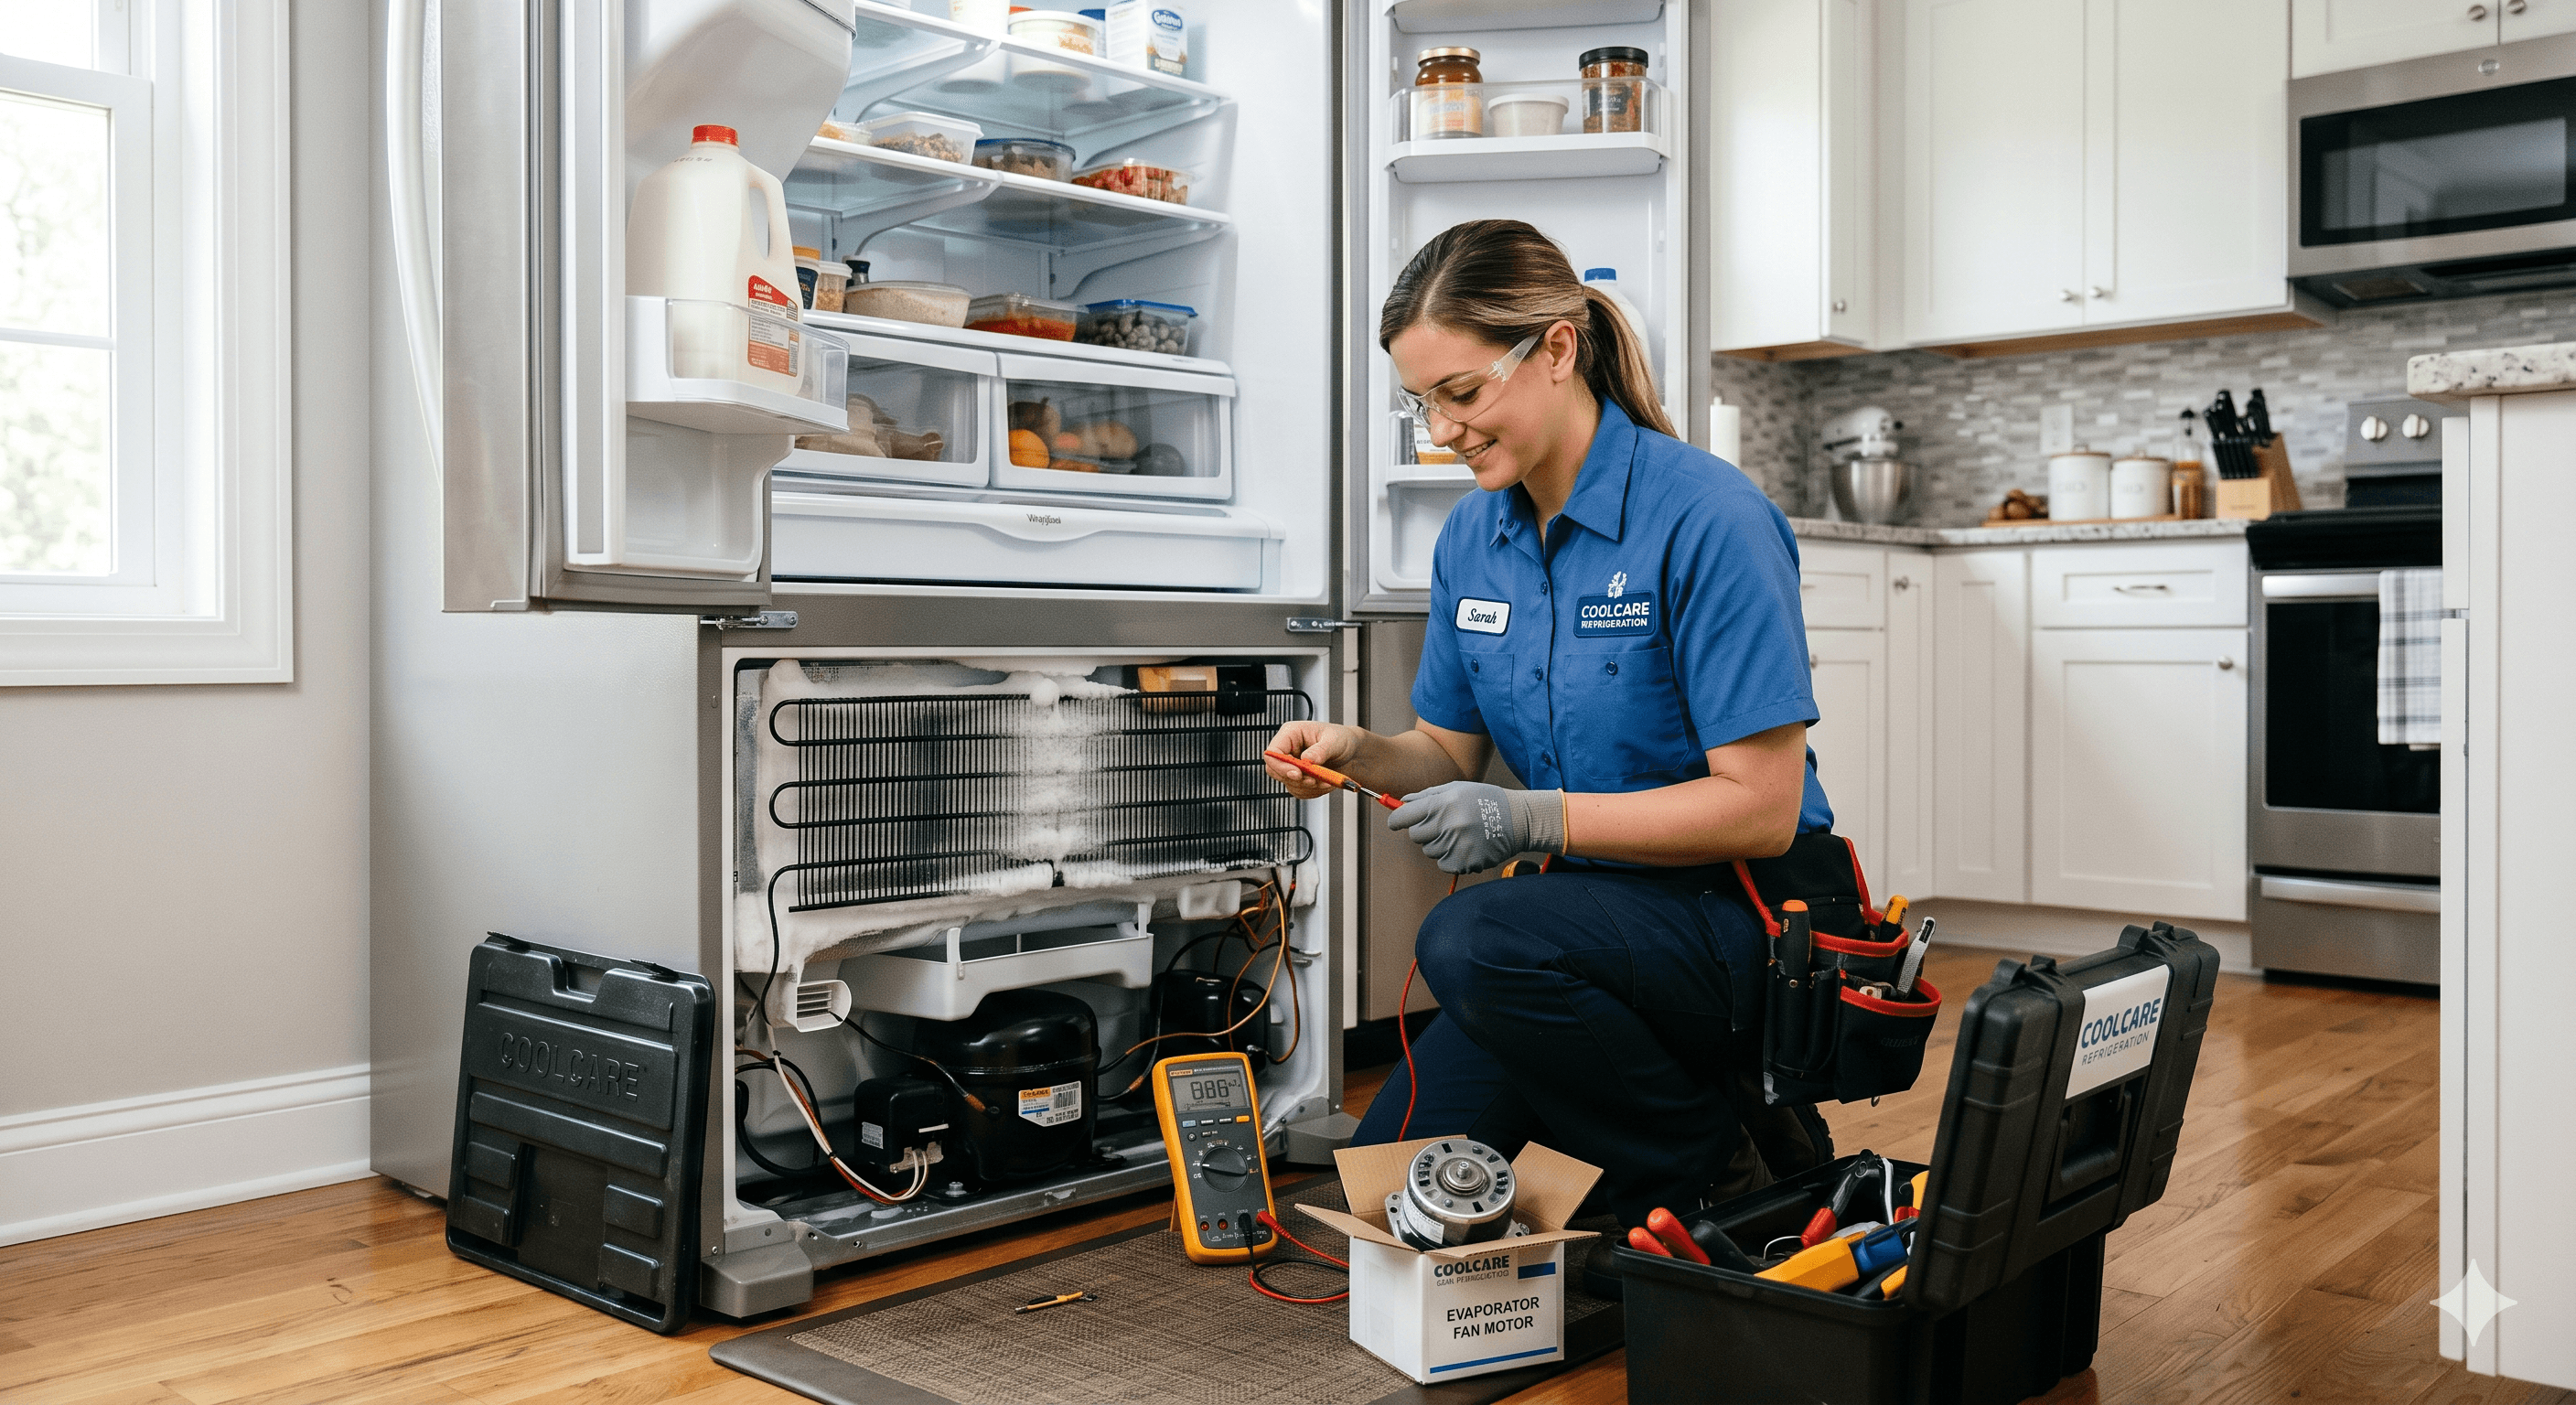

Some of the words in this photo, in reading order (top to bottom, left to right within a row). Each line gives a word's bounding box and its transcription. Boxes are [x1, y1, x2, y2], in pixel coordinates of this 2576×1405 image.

[1467, 607, 1497, 625] Sarah
[1582, 601, 1650, 618] COOLCARE
[2081, 998, 2162, 1049] COOLCARE
[500, 1032, 639, 1102] COOLCARE
[1433, 1255, 1510, 1278] COOLCARE
[1446, 1296, 1540, 1323] EVAPORATOR
[1453, 1323, 1481, 1340] FAN
[1484, 1315, 1535, 1335] MOTOR
